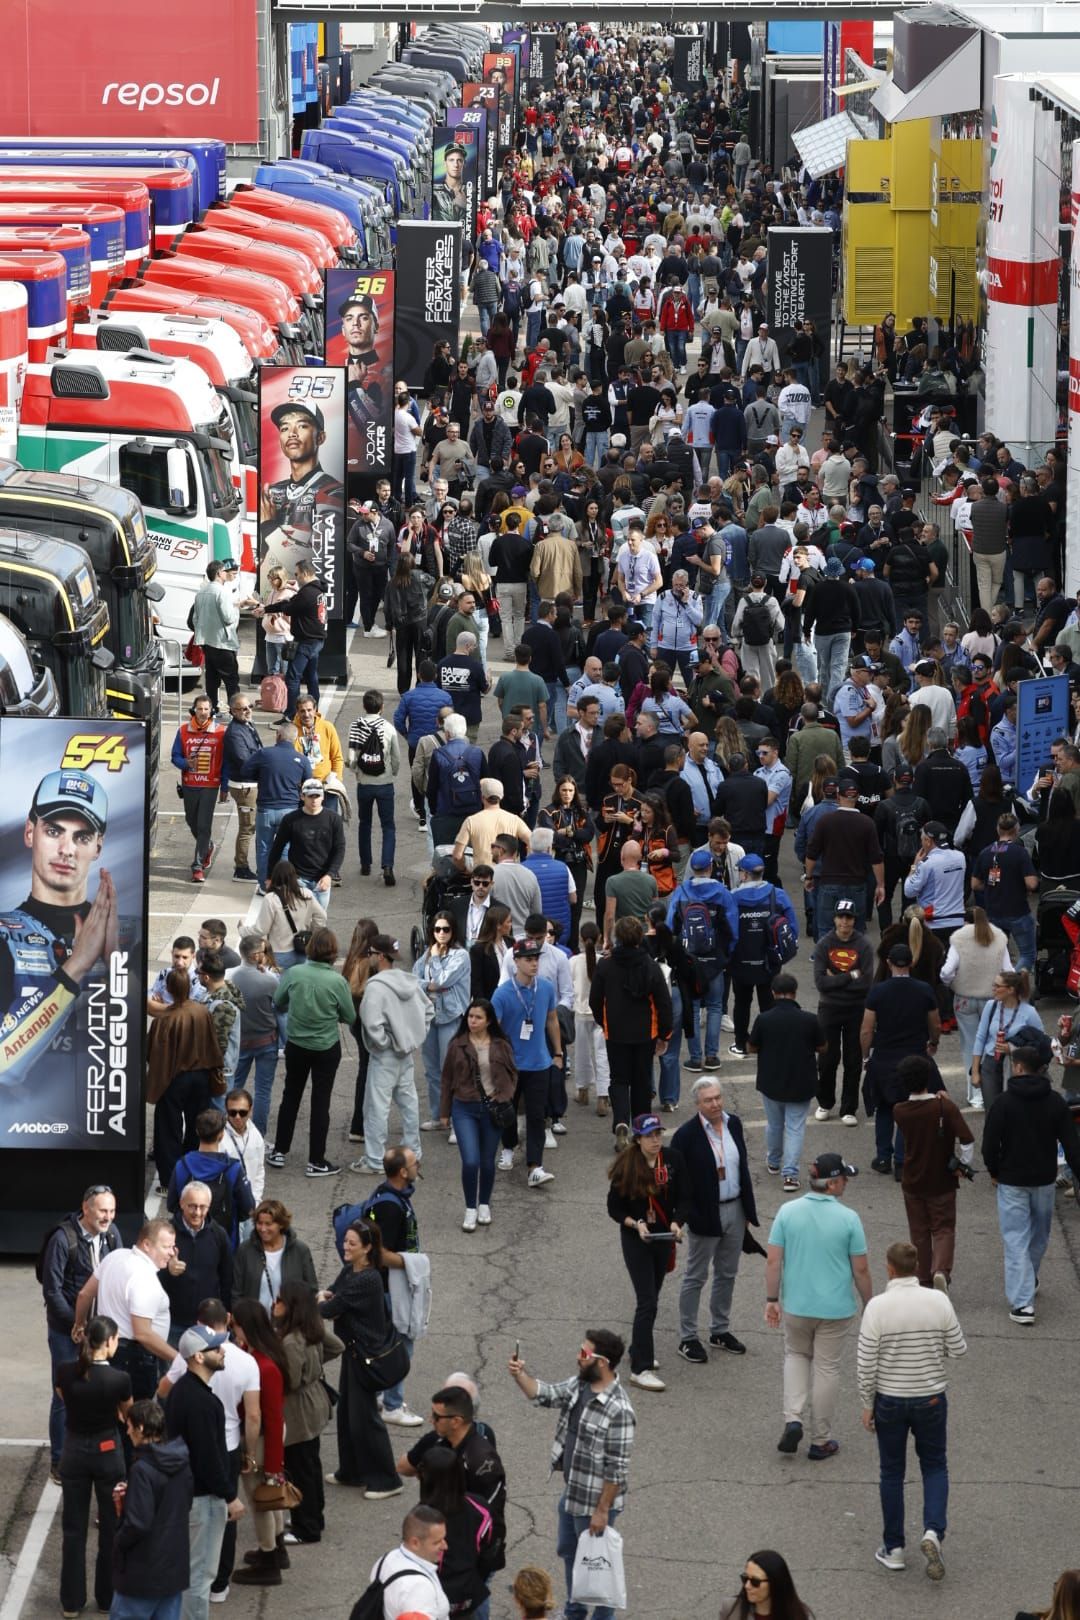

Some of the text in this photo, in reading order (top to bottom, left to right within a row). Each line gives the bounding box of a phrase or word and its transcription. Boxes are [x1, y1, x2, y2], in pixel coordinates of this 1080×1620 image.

[102, 77, 220, 111] repsol
[480, 87, 495, 99] 23
[462, 112, 482, 123] 88
[354, 277, 387, 295] 36
[425, 256, 435, 323] FASTER
[434, 239, 445, 323] FORWARD
[443, 234, 454, 323] FEARLESS
[774, 270, 783, 328] WELCOME
[782, 251, 791, 328] TO THE MOST
[789, 239, 799, 328] EXCITING SPORT
[797, 273, 806, 311] EARTH
[288, 375, 336, 399] 35
[366, 421, 376, 466] JOAN
[376, 425, 386, 466] MIR
[146, 533, 172, 545] HANN
[324, 512, 336, 611] CHANTRA
[60, 733, 130, 772] 54
[16, 990, 45, 1019] NEWS
[4, 1001, 60, 1062] Antangin
[108, 950, 129, 1137] ALDEGUER
[86, 983, 107, 1136] FERMIN
[7, 1122, 70, 1135] MotoGP
